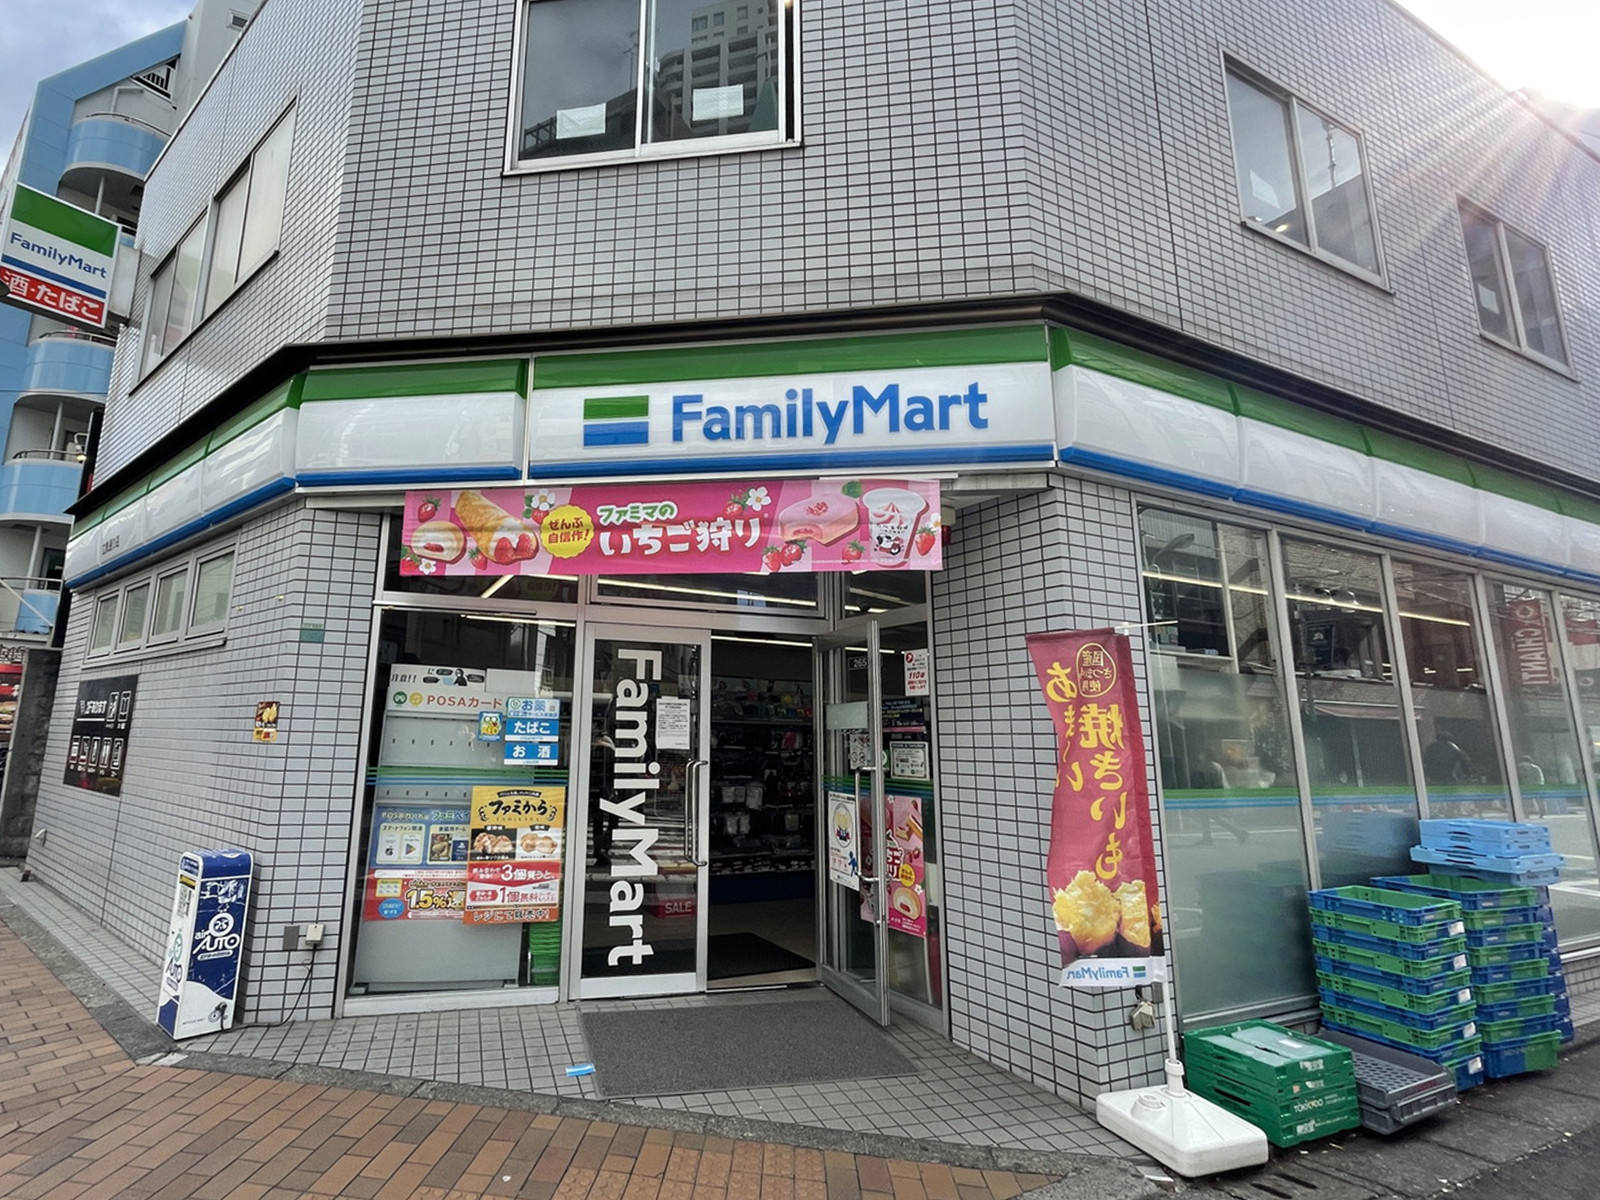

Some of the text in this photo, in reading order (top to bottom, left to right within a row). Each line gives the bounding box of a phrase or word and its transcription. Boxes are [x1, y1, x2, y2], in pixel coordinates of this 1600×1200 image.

[10, 232, 107, 279] FamilyMart
[672, 381, 989, 445] FamilyMart
[598, 501, 675, 524] ファミマの
[548, 518, 584, 531] ぜんぶ
[599, 517, 761, 557] いちご狩り
[427, 695, 502, 708] POSAカード
[514, 721, 551, 734] たばこ
[488, 799, 548, 816] ファミから
[599, 649, 662, 966] FamilyMart
[664, 902, 692, 914] SALE
[192, 935, 240, 954] AUTO
